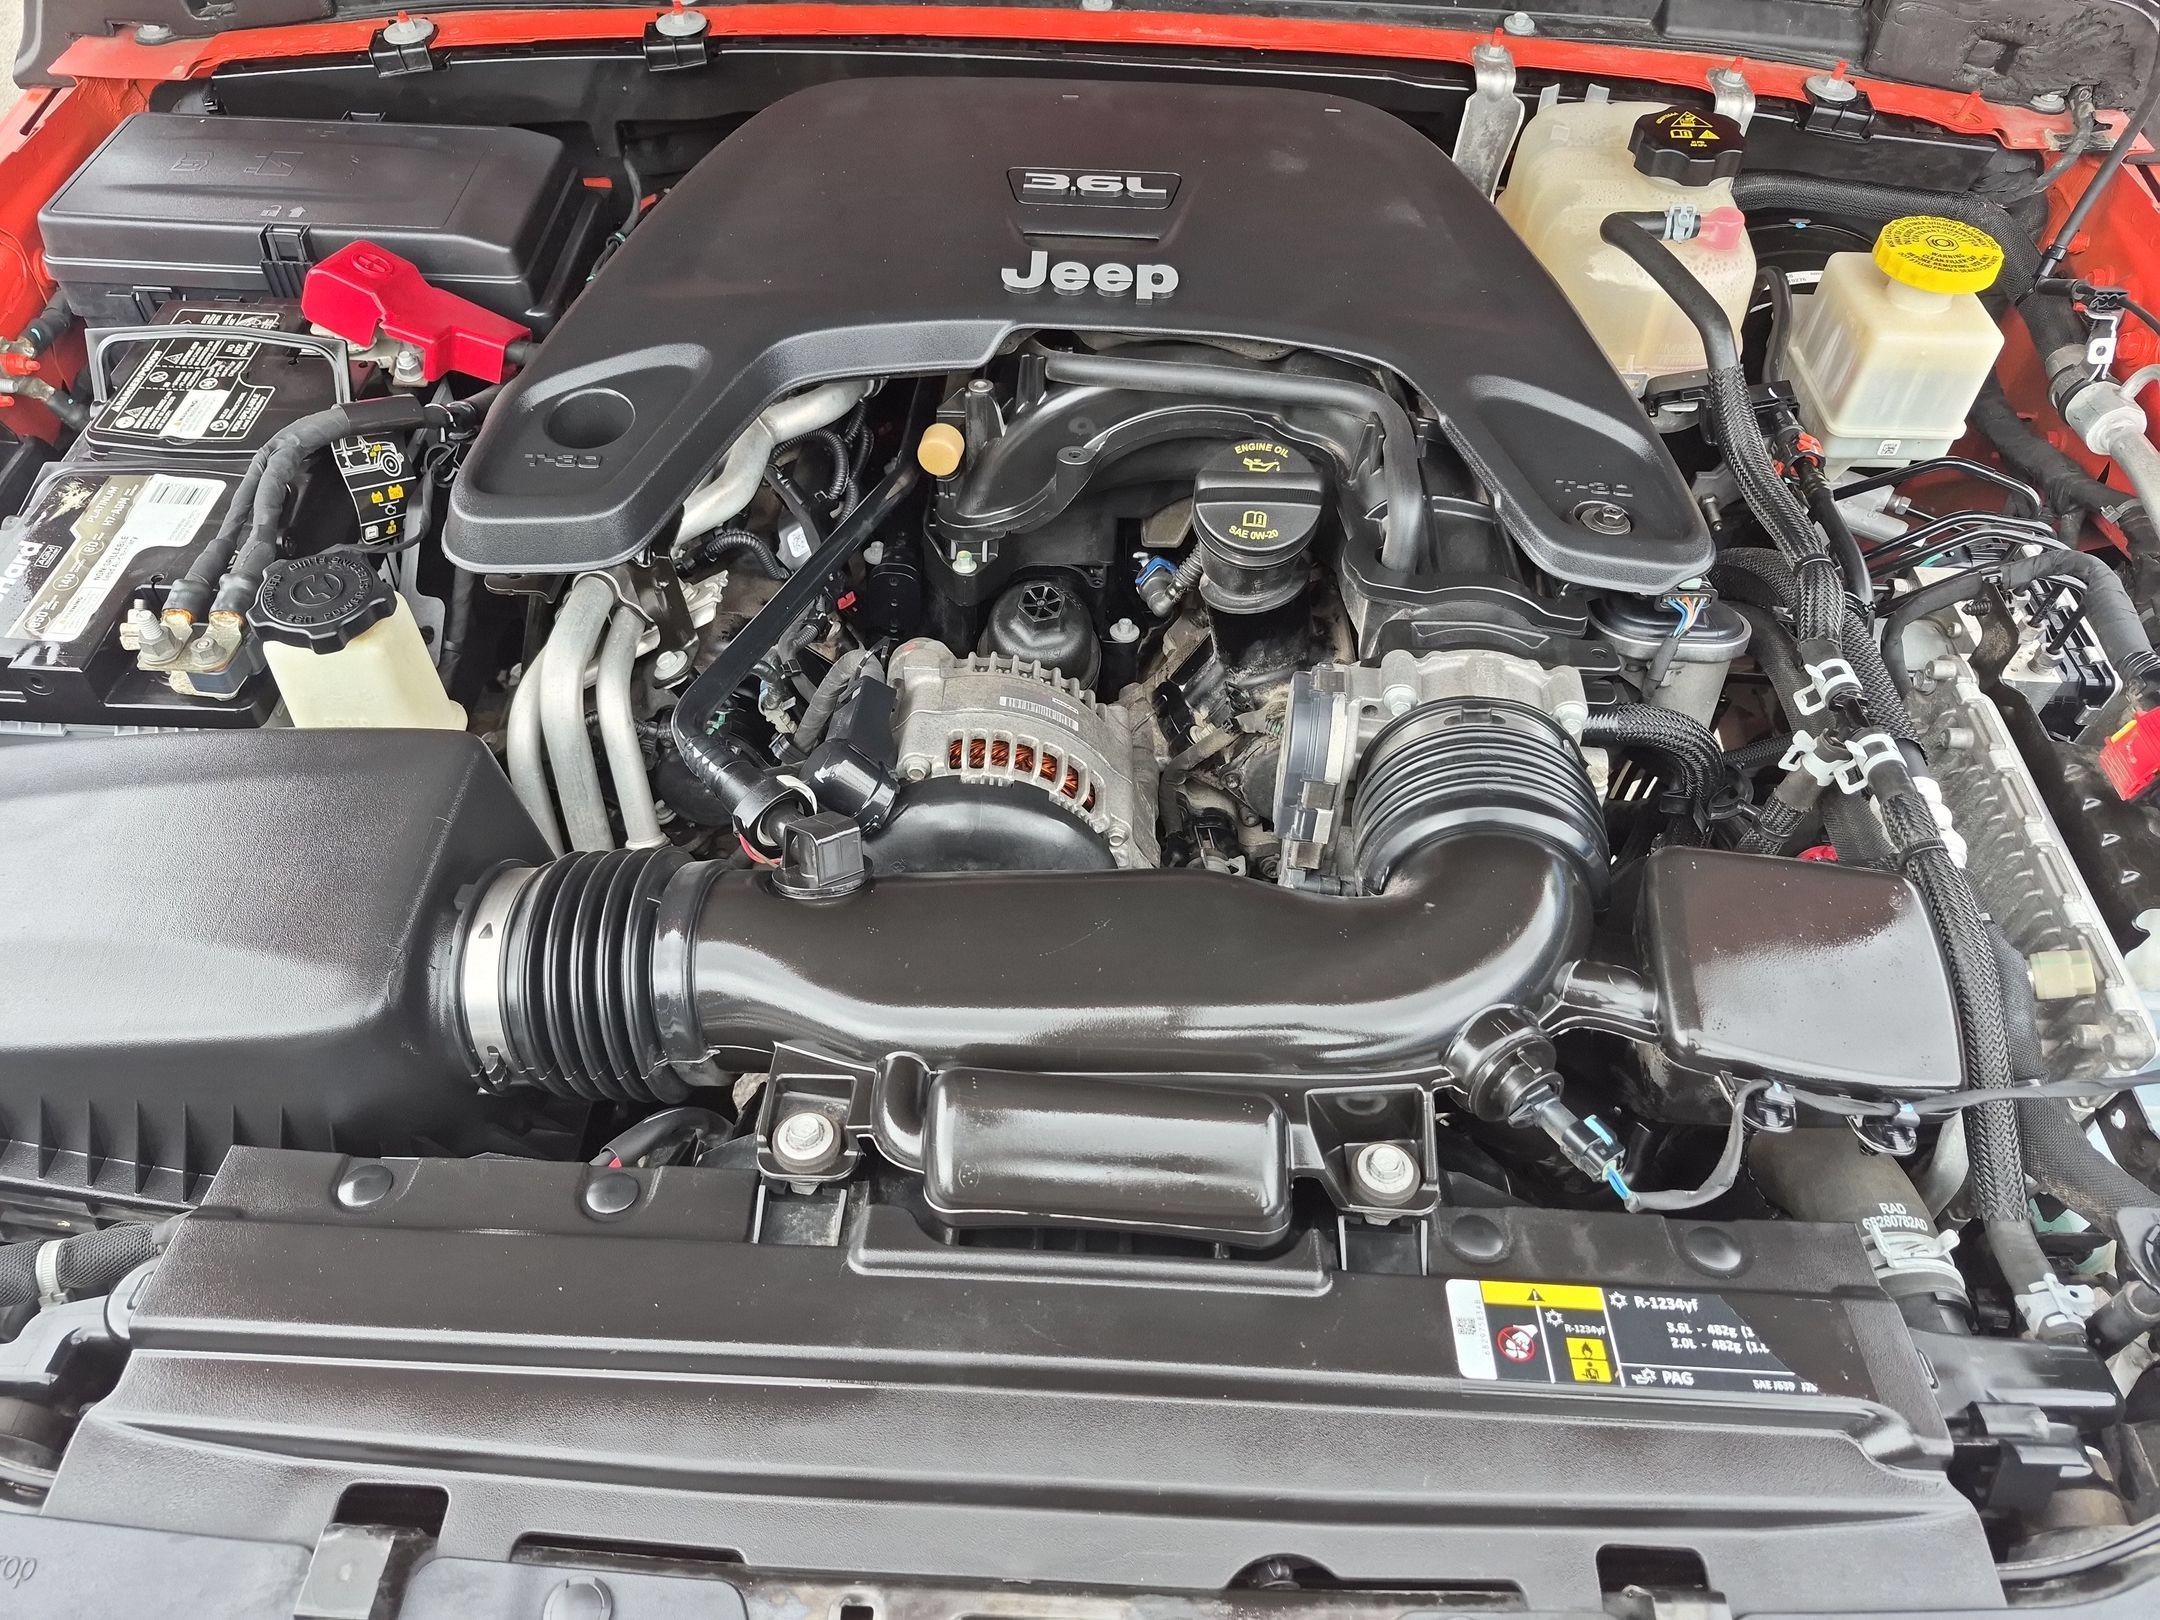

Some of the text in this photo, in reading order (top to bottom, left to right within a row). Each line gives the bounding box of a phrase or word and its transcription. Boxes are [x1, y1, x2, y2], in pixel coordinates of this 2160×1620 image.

[1023, 172, 1167, 199] 3.6L
[1001, 250, 1179, 303] Jeep
[1234, 442, 1289, 458] ENGINE OIL
[86, 487, 120, 522] PLATINUM
[101, 497, 132, 526] H7-AGM
[1228, 525, 1279, 540] SAE 0W-20
[81, 541, 100, 553] 80
[37, 546, 55, 565] AGM
[57, 573, 77, 589] 140
[1879, 1203, 1906, 1214] RAD
[1634, 1296, 1698, 1314] R-1234yf
[1565, 1324, 1606, 1336] R-1234yf
[1666, 1322, 1693, 1334] 3.6L
[1707, 1324, 1738, 1339] 482g
[1671, 1337, 1697, 1350] 2.0L
[1712, 1339, 1742, 1354] 482g
[1662, 1371, 1694, 1386] PAG
[1753, 1380, 1772, 1390] SAE
